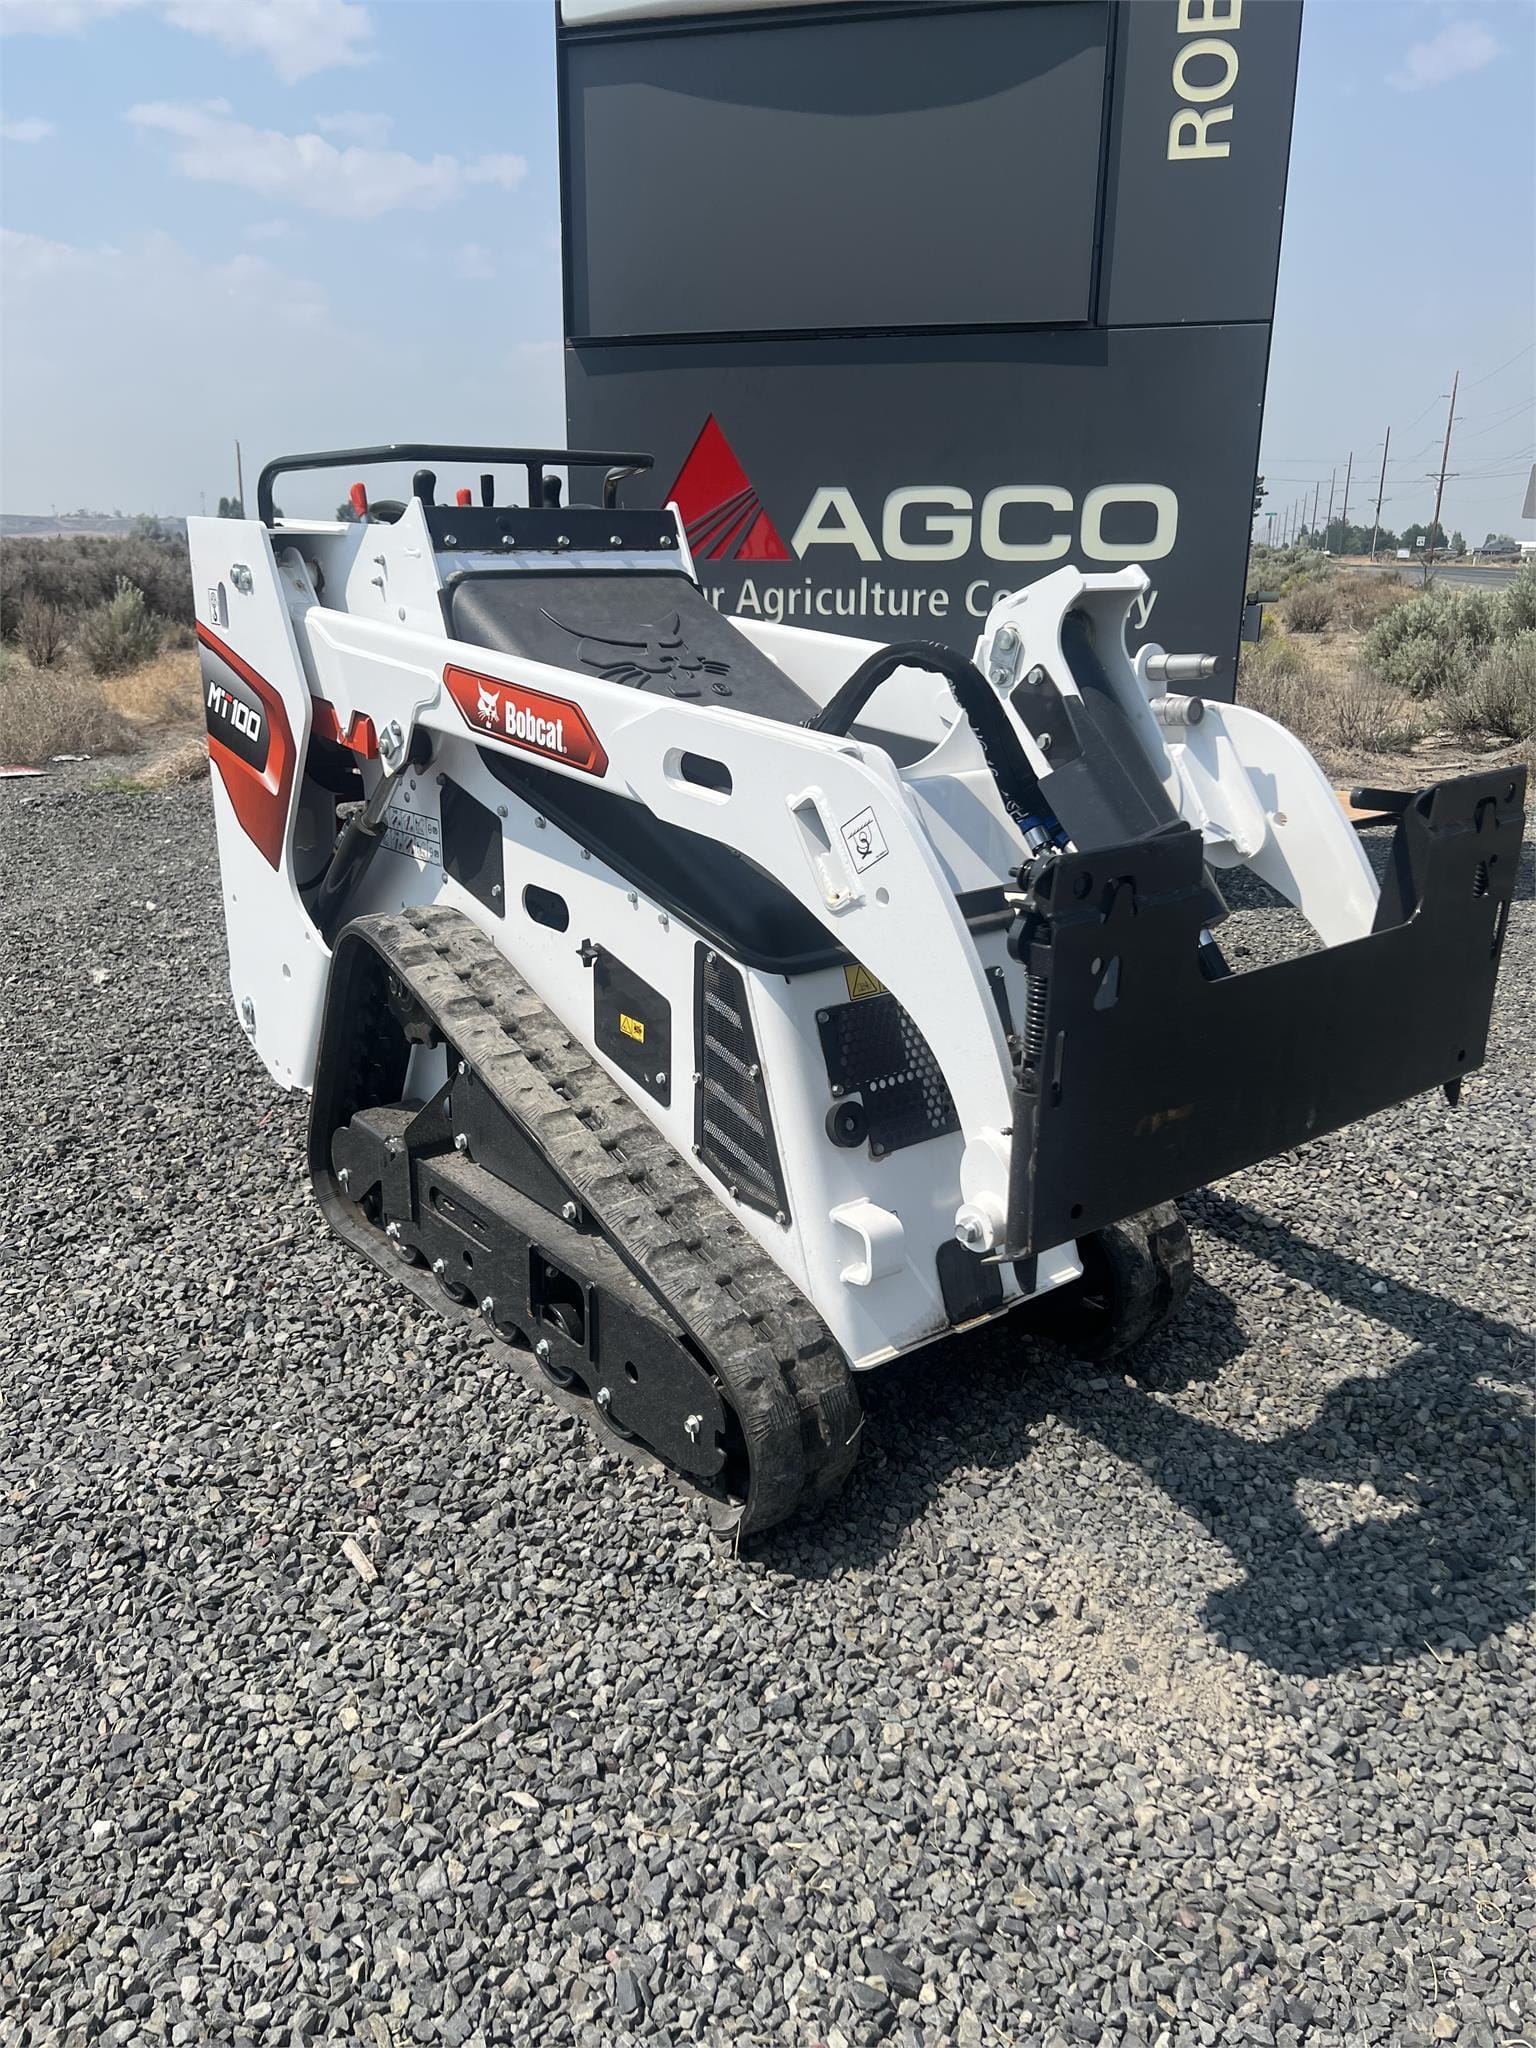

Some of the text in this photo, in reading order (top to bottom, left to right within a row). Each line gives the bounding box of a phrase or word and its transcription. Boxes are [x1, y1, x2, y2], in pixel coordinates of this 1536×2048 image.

[791, 483, 1179, 562] AGCO
[736, 576, 950, 624] Agriculture
[207, 681, 262, 742] MT100
[505, 700, 564, 753] Bobcat
